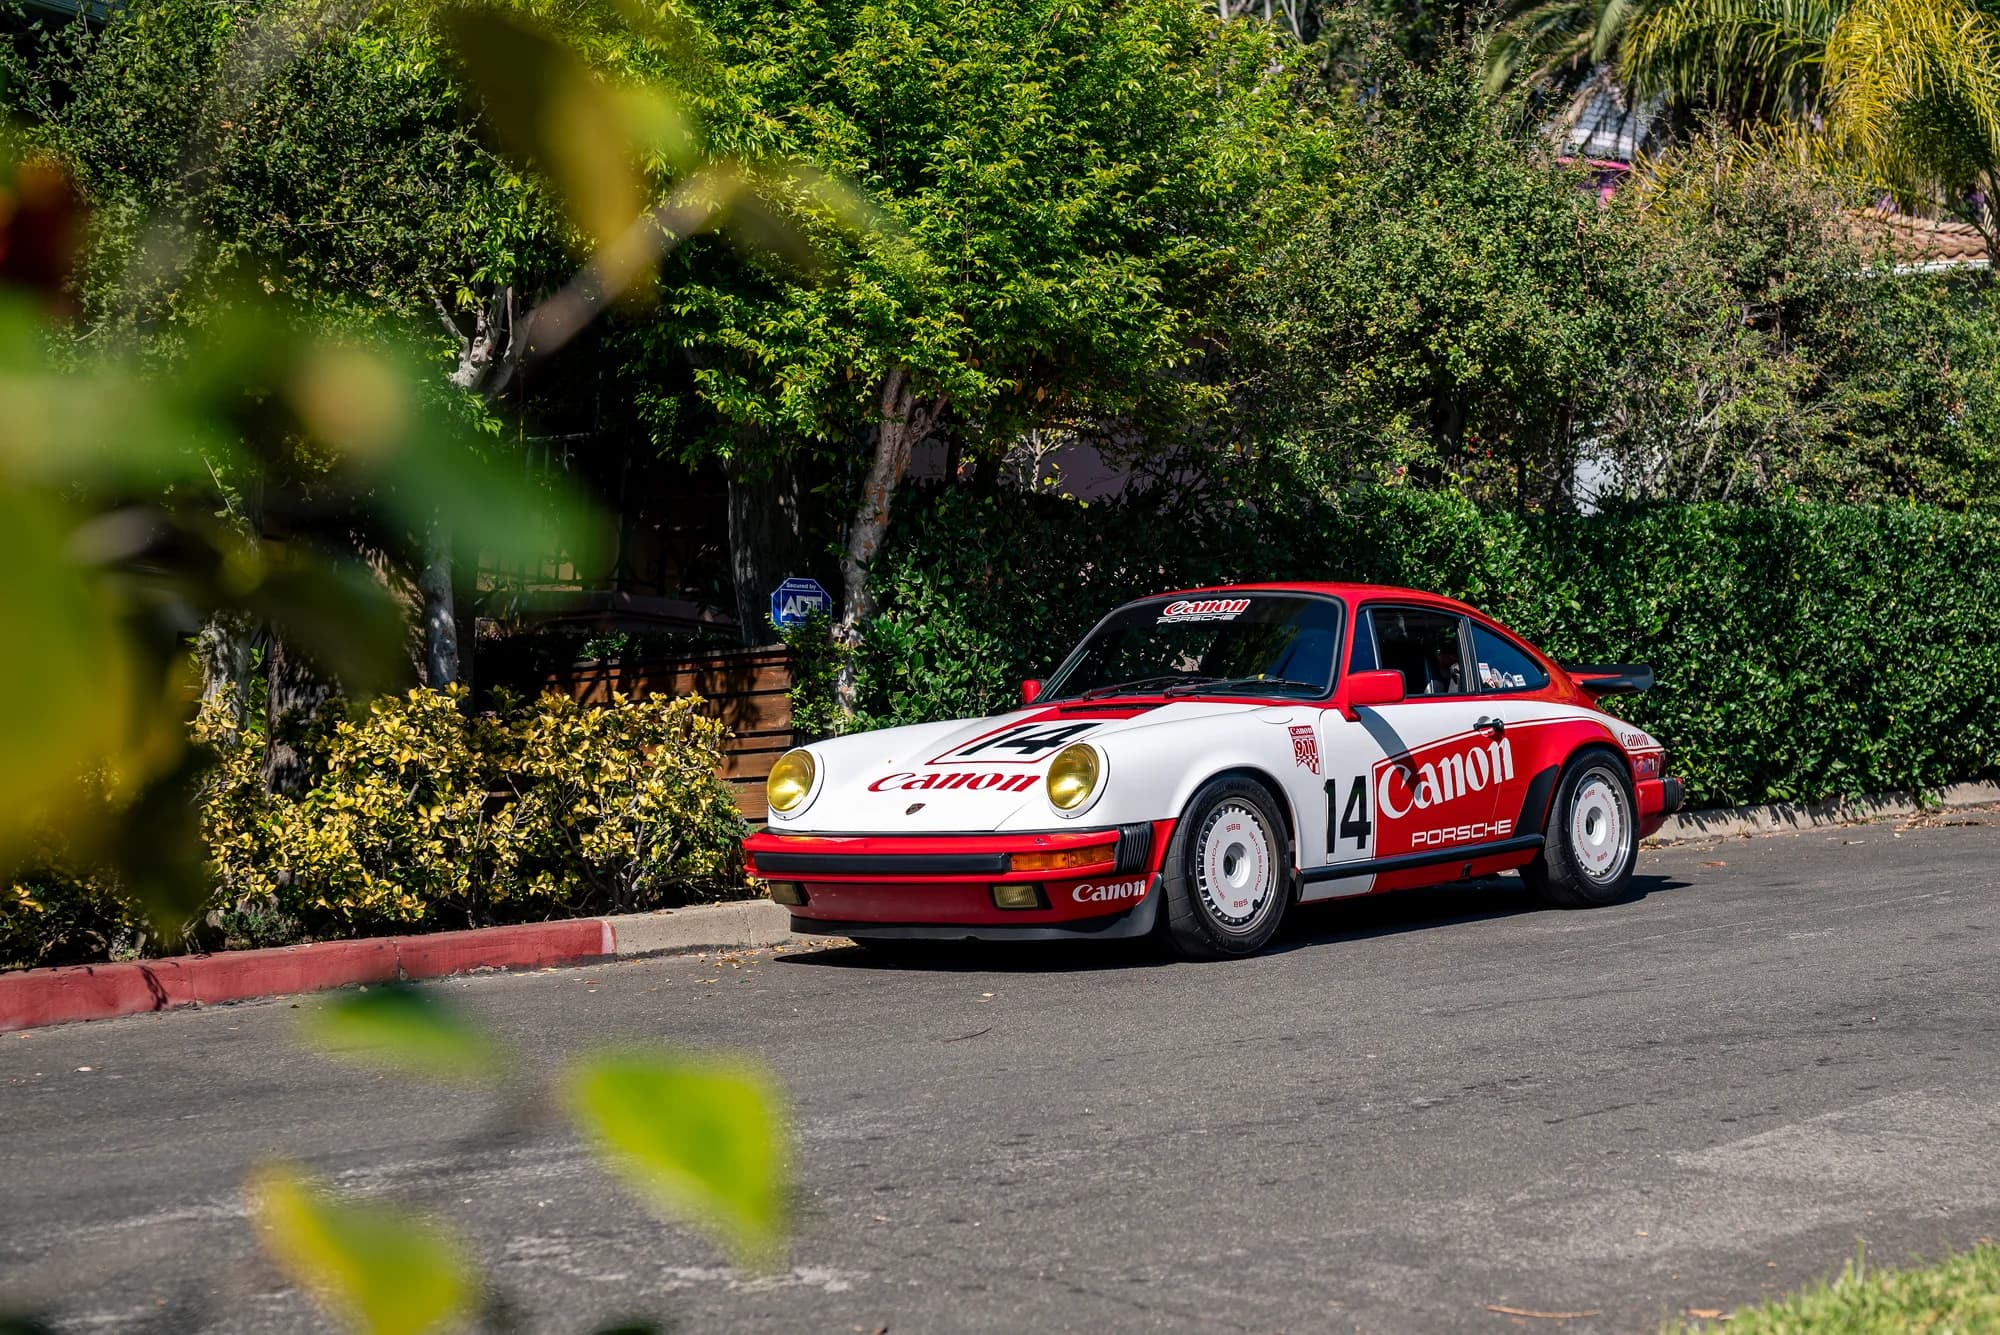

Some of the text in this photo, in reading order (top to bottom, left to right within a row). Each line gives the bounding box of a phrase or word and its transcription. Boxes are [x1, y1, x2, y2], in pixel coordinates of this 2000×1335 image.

[782, 595, 821, 617] ADT
[1163, 599, 1251, 616] Canon
[1156, 614, 1237, 625] PORSCHE
[955, 722, 1104, 757] 14
[1290, 727, 1313, 735] Canon
[1620, 732, 1649, 747] Canon
[1294, 738, 1317, 757] 911
[867, 772, 1041, 792] Canon
[1378, 737, 1514, 820] Canon
[1324, 775, 1371, 854] 14
[1226, 823, 1241, 833] BBS
[1411, 819, 1512, 847] PORSCHE
[1072, 880, 1146, 902] Canon
[1233, 898, 1249, 908] BBS
